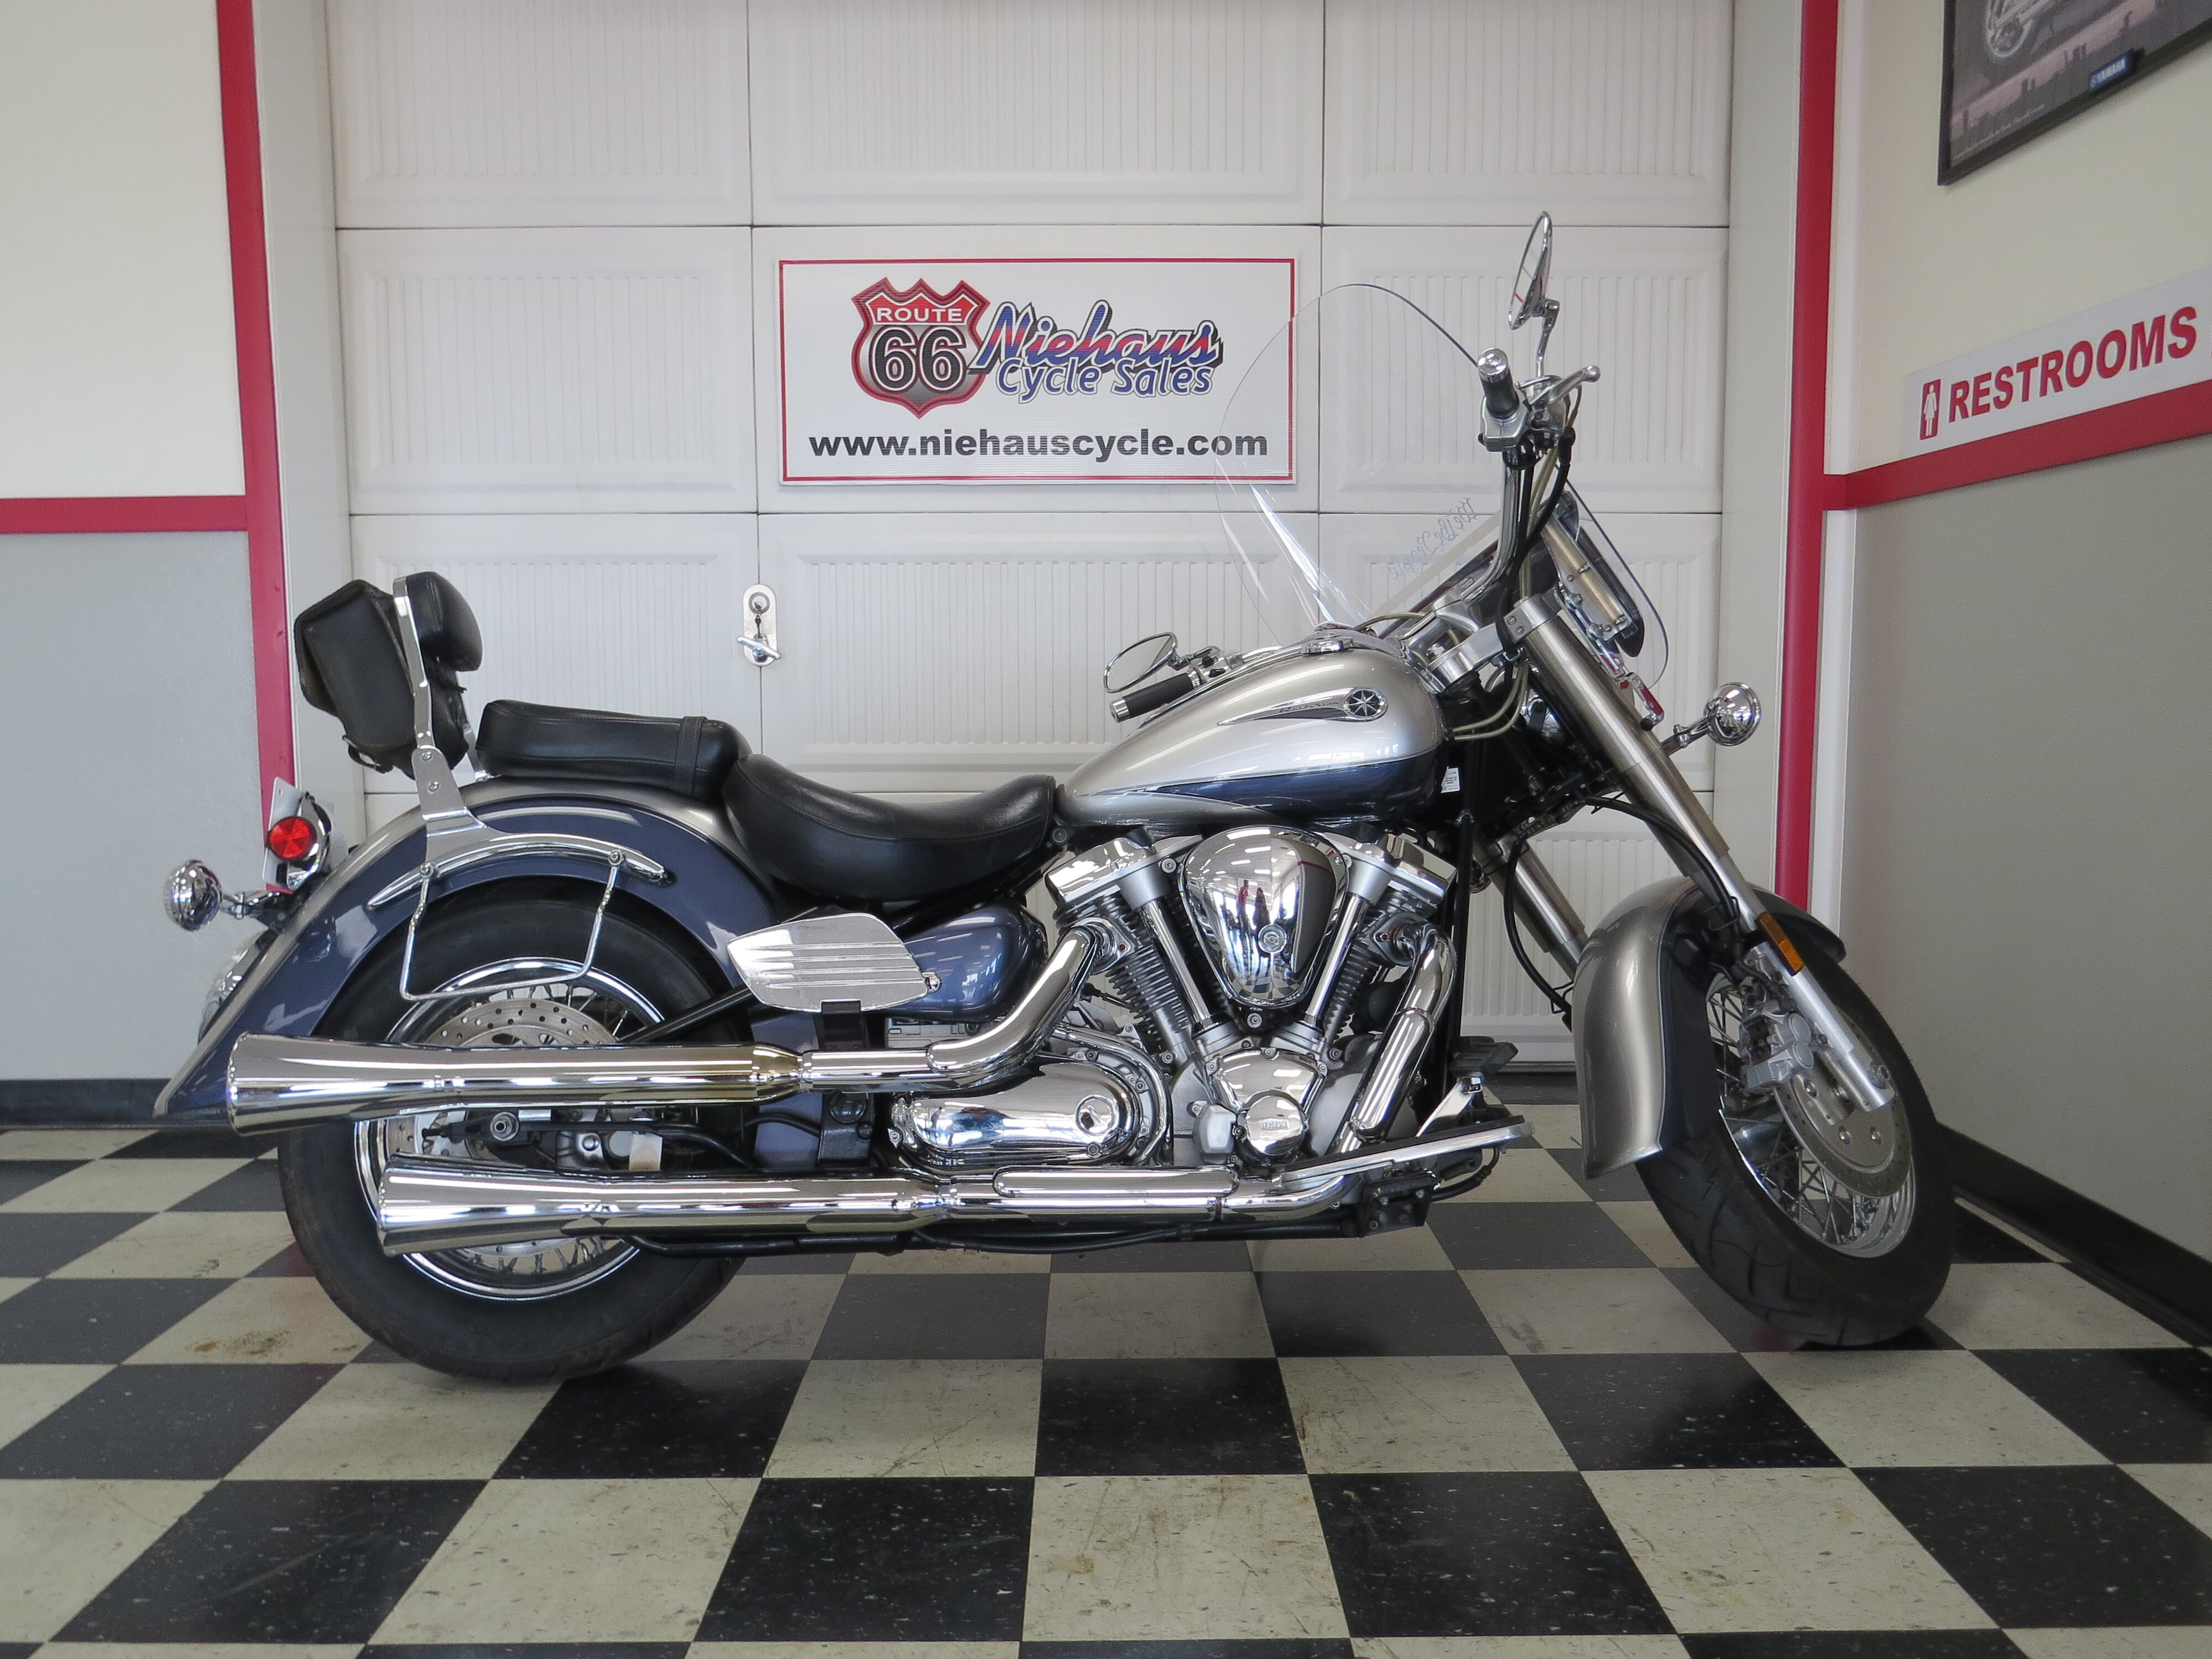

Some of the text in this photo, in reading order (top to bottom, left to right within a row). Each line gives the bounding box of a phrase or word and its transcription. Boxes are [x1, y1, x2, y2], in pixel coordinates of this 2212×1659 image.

[876, 307, 962, 323] ROUTE
[968, 299, 1223, 374] Niehaus
[869, 325, 968, 394] 66
[995, 357, 1213, 404] Cycle Sales
[1948, 306, 2197, 423] RESTROOMS
[808, 429, 1268, 462] www.niehauscycle.com
